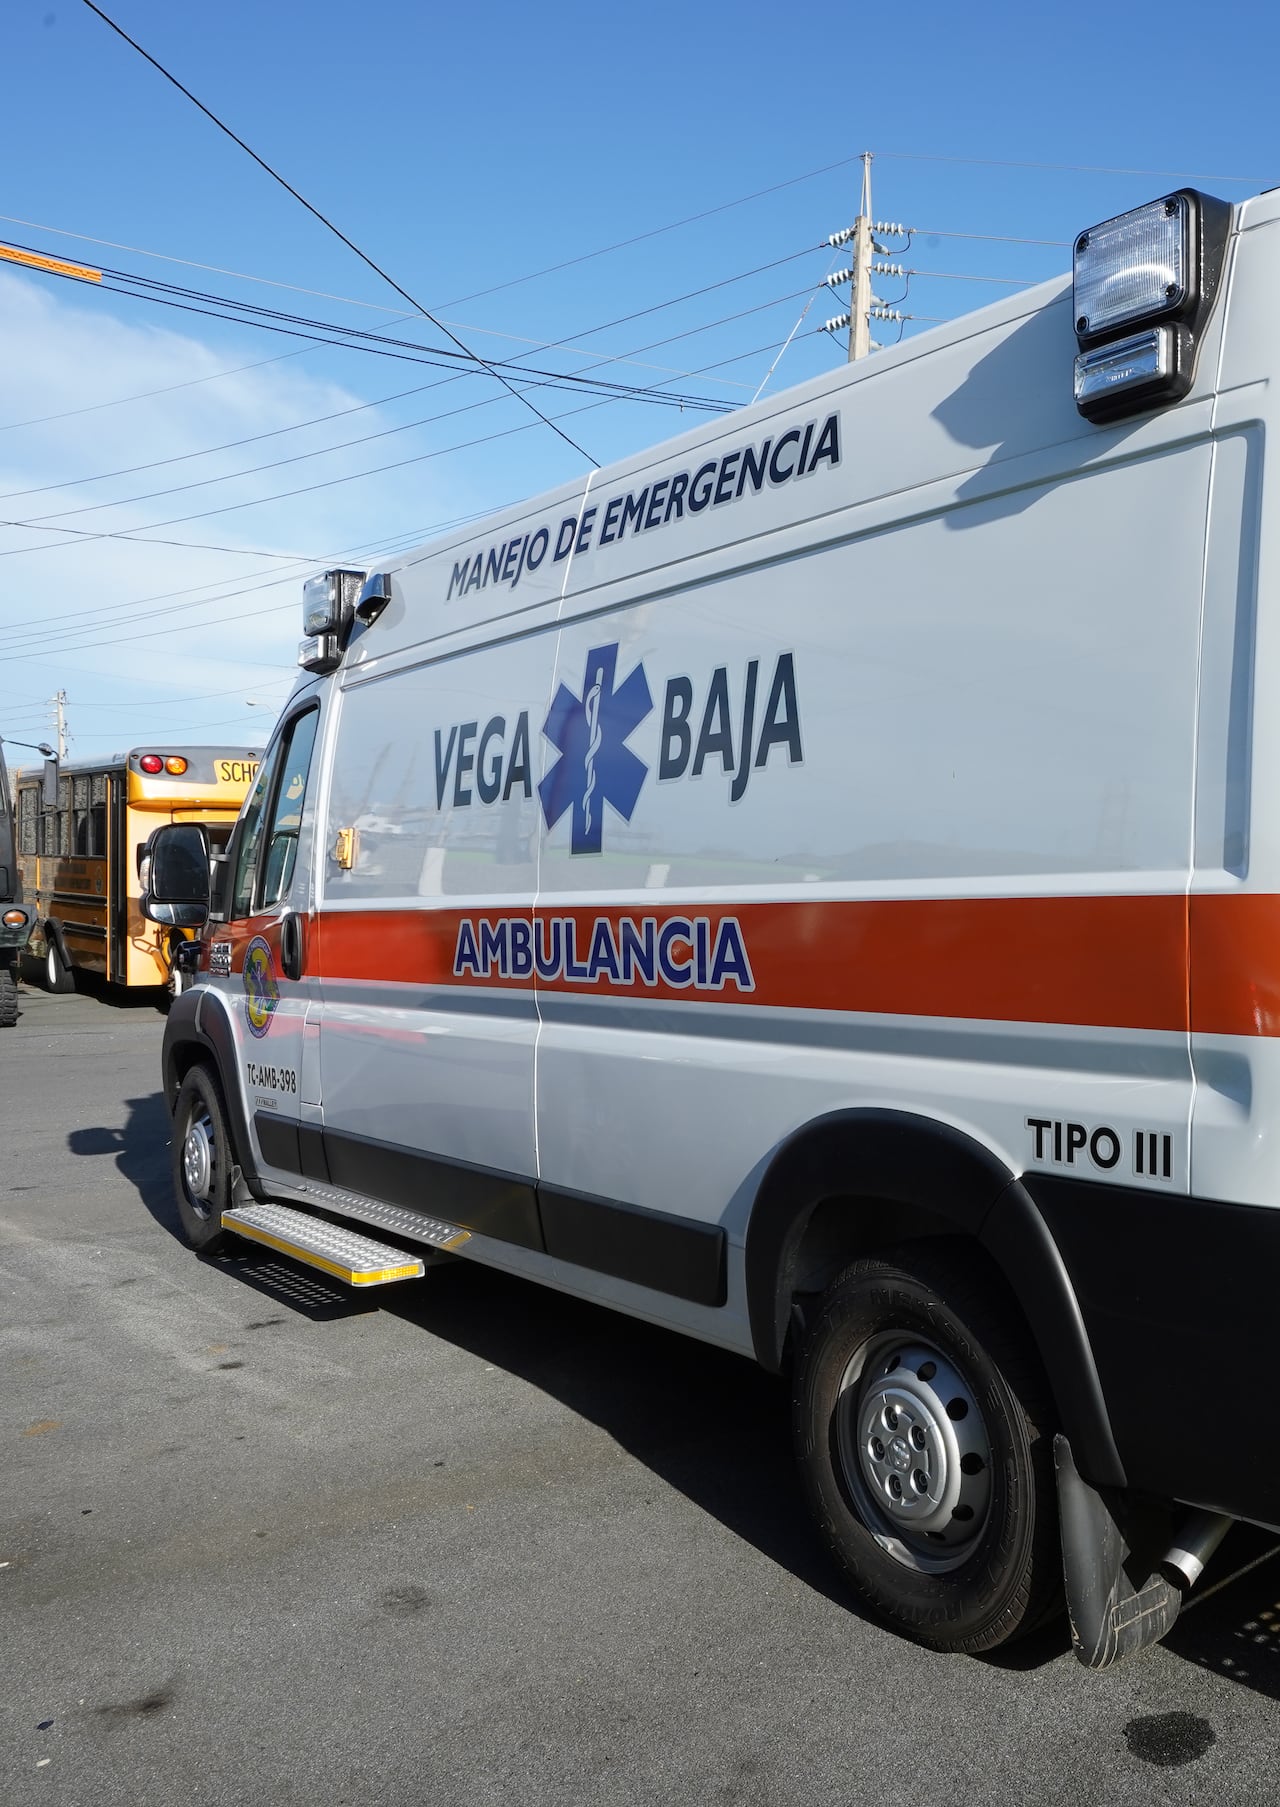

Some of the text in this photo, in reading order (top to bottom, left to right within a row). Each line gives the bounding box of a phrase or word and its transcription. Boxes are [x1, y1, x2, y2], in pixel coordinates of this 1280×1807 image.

[447, 415, 840, 600] MANEJO DE EMERGENCIA
[434, 652, 803, 811] VEGA BAJA
[455, 919, 752, 990] AMBULANCIA
[247, 1063, 297, 1094] TC-AMB-398
[1027, 1118, 1171, 1178] TIPO III
